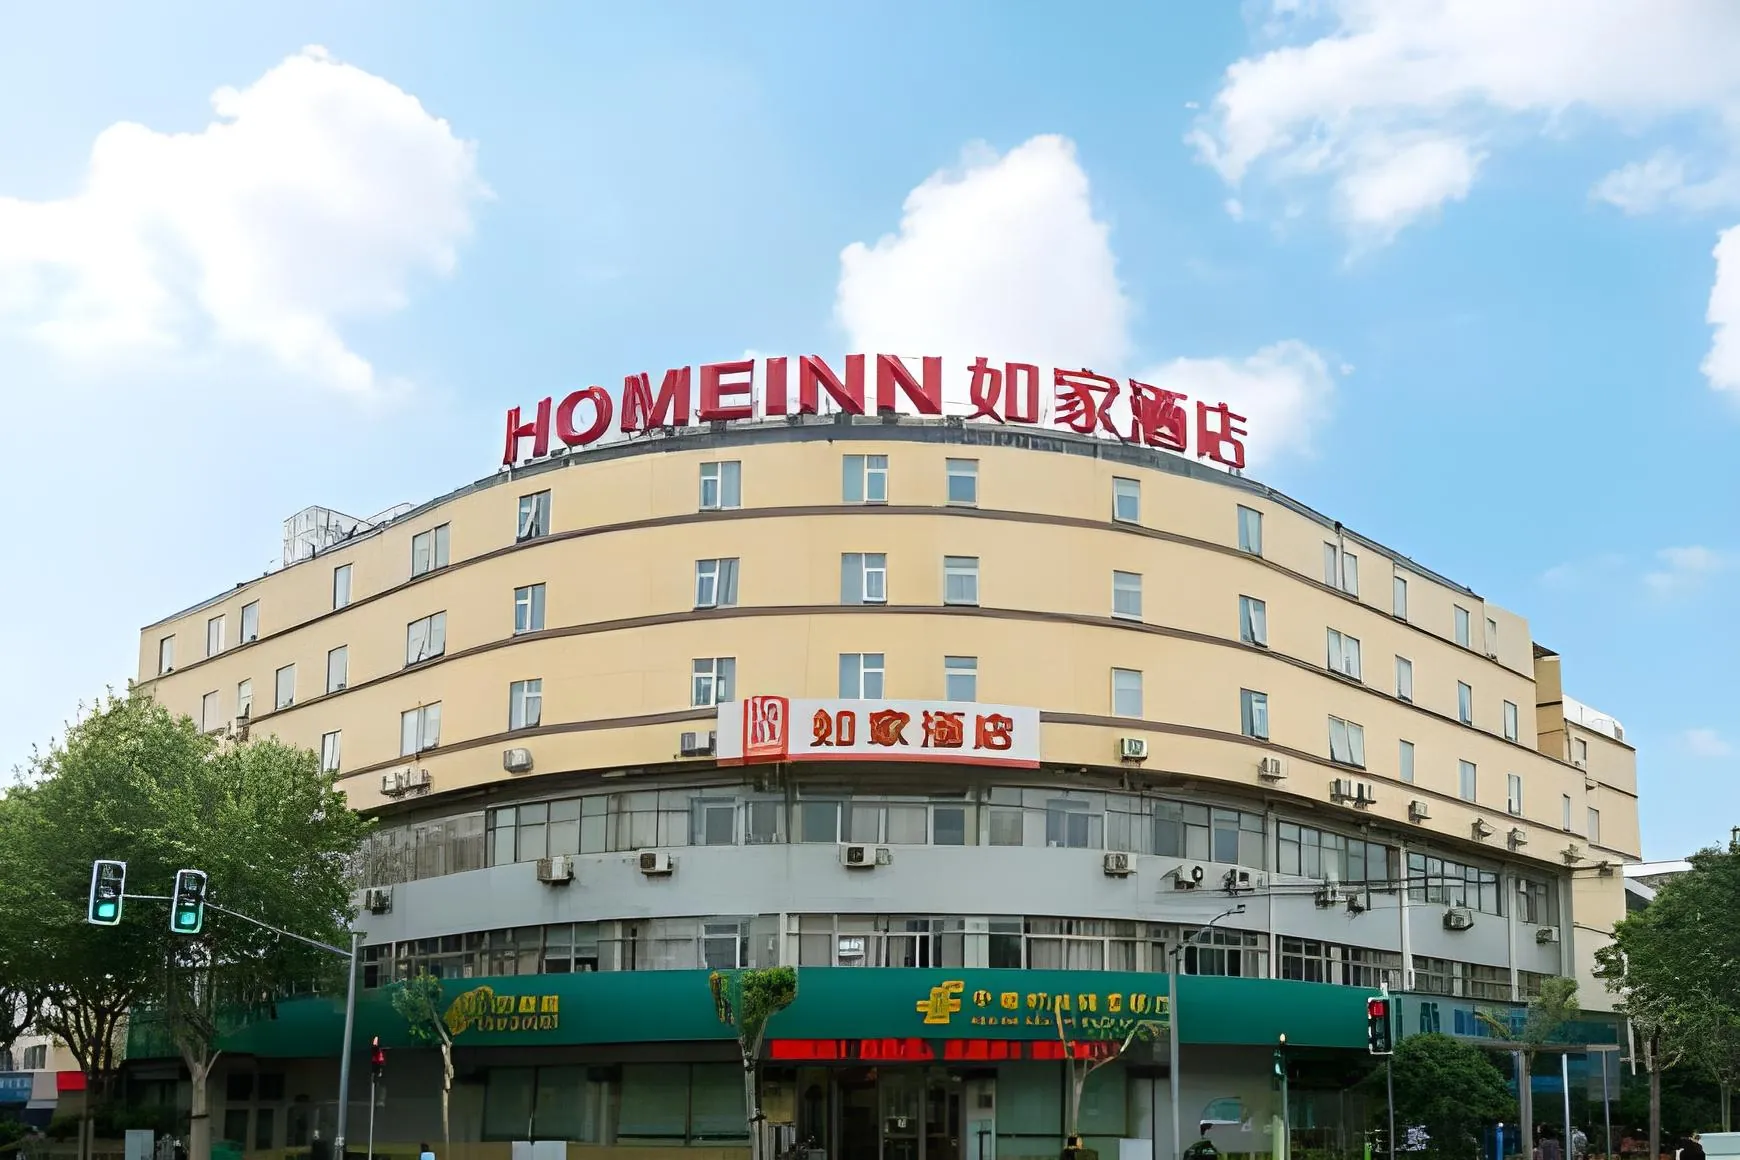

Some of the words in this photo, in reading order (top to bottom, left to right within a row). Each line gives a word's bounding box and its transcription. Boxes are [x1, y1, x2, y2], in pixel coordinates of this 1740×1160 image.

[966, 356, 1248, 469] 如家酒店
[810, 708, 1013, 750] 如家酒店
